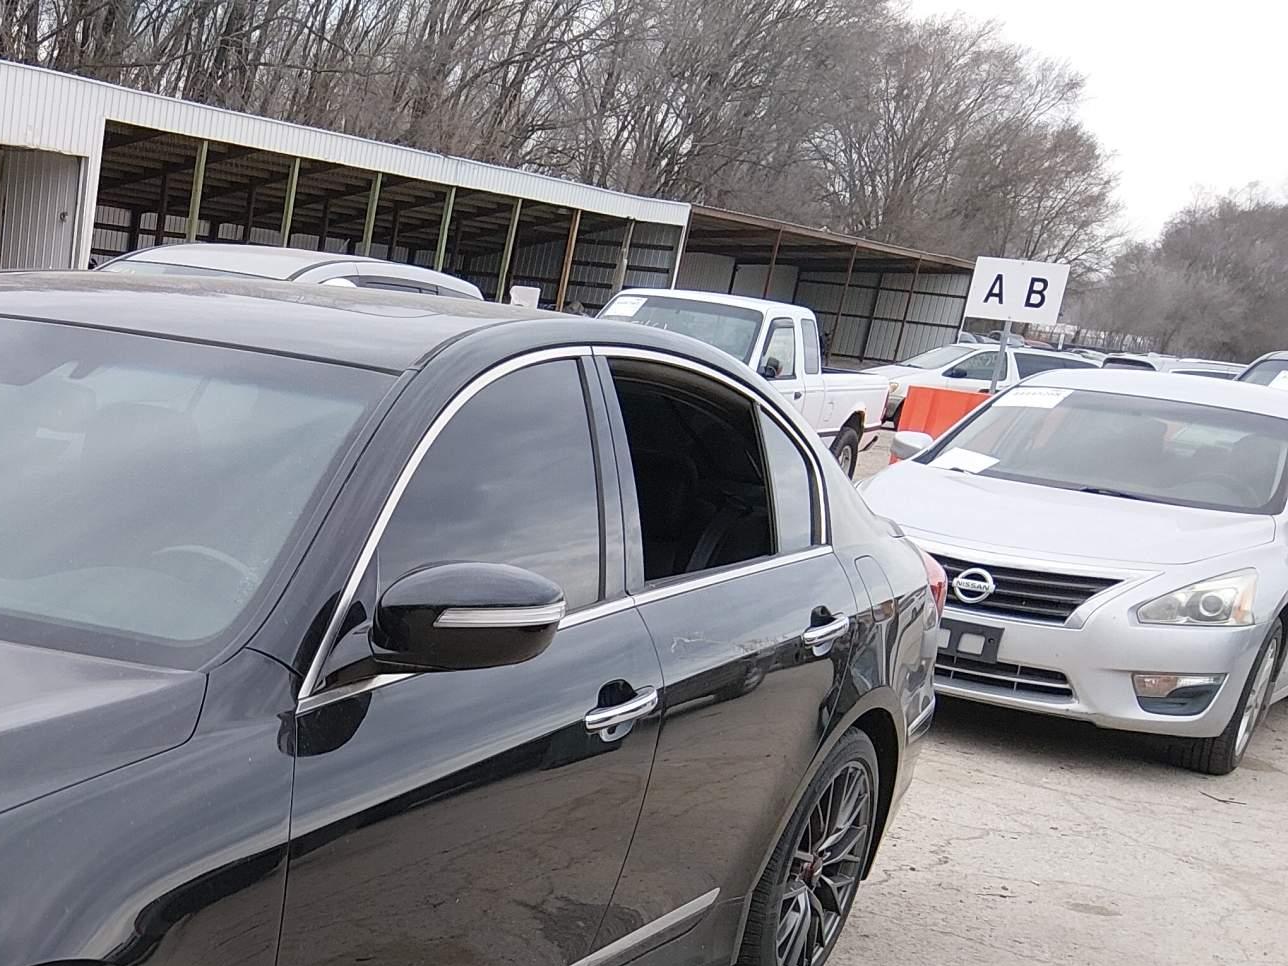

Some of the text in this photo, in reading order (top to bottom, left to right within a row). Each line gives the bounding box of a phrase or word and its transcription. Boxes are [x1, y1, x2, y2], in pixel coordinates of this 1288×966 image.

[983, 273, 1049, 309] A B
[956, 580, 990, 591] NISSAN
